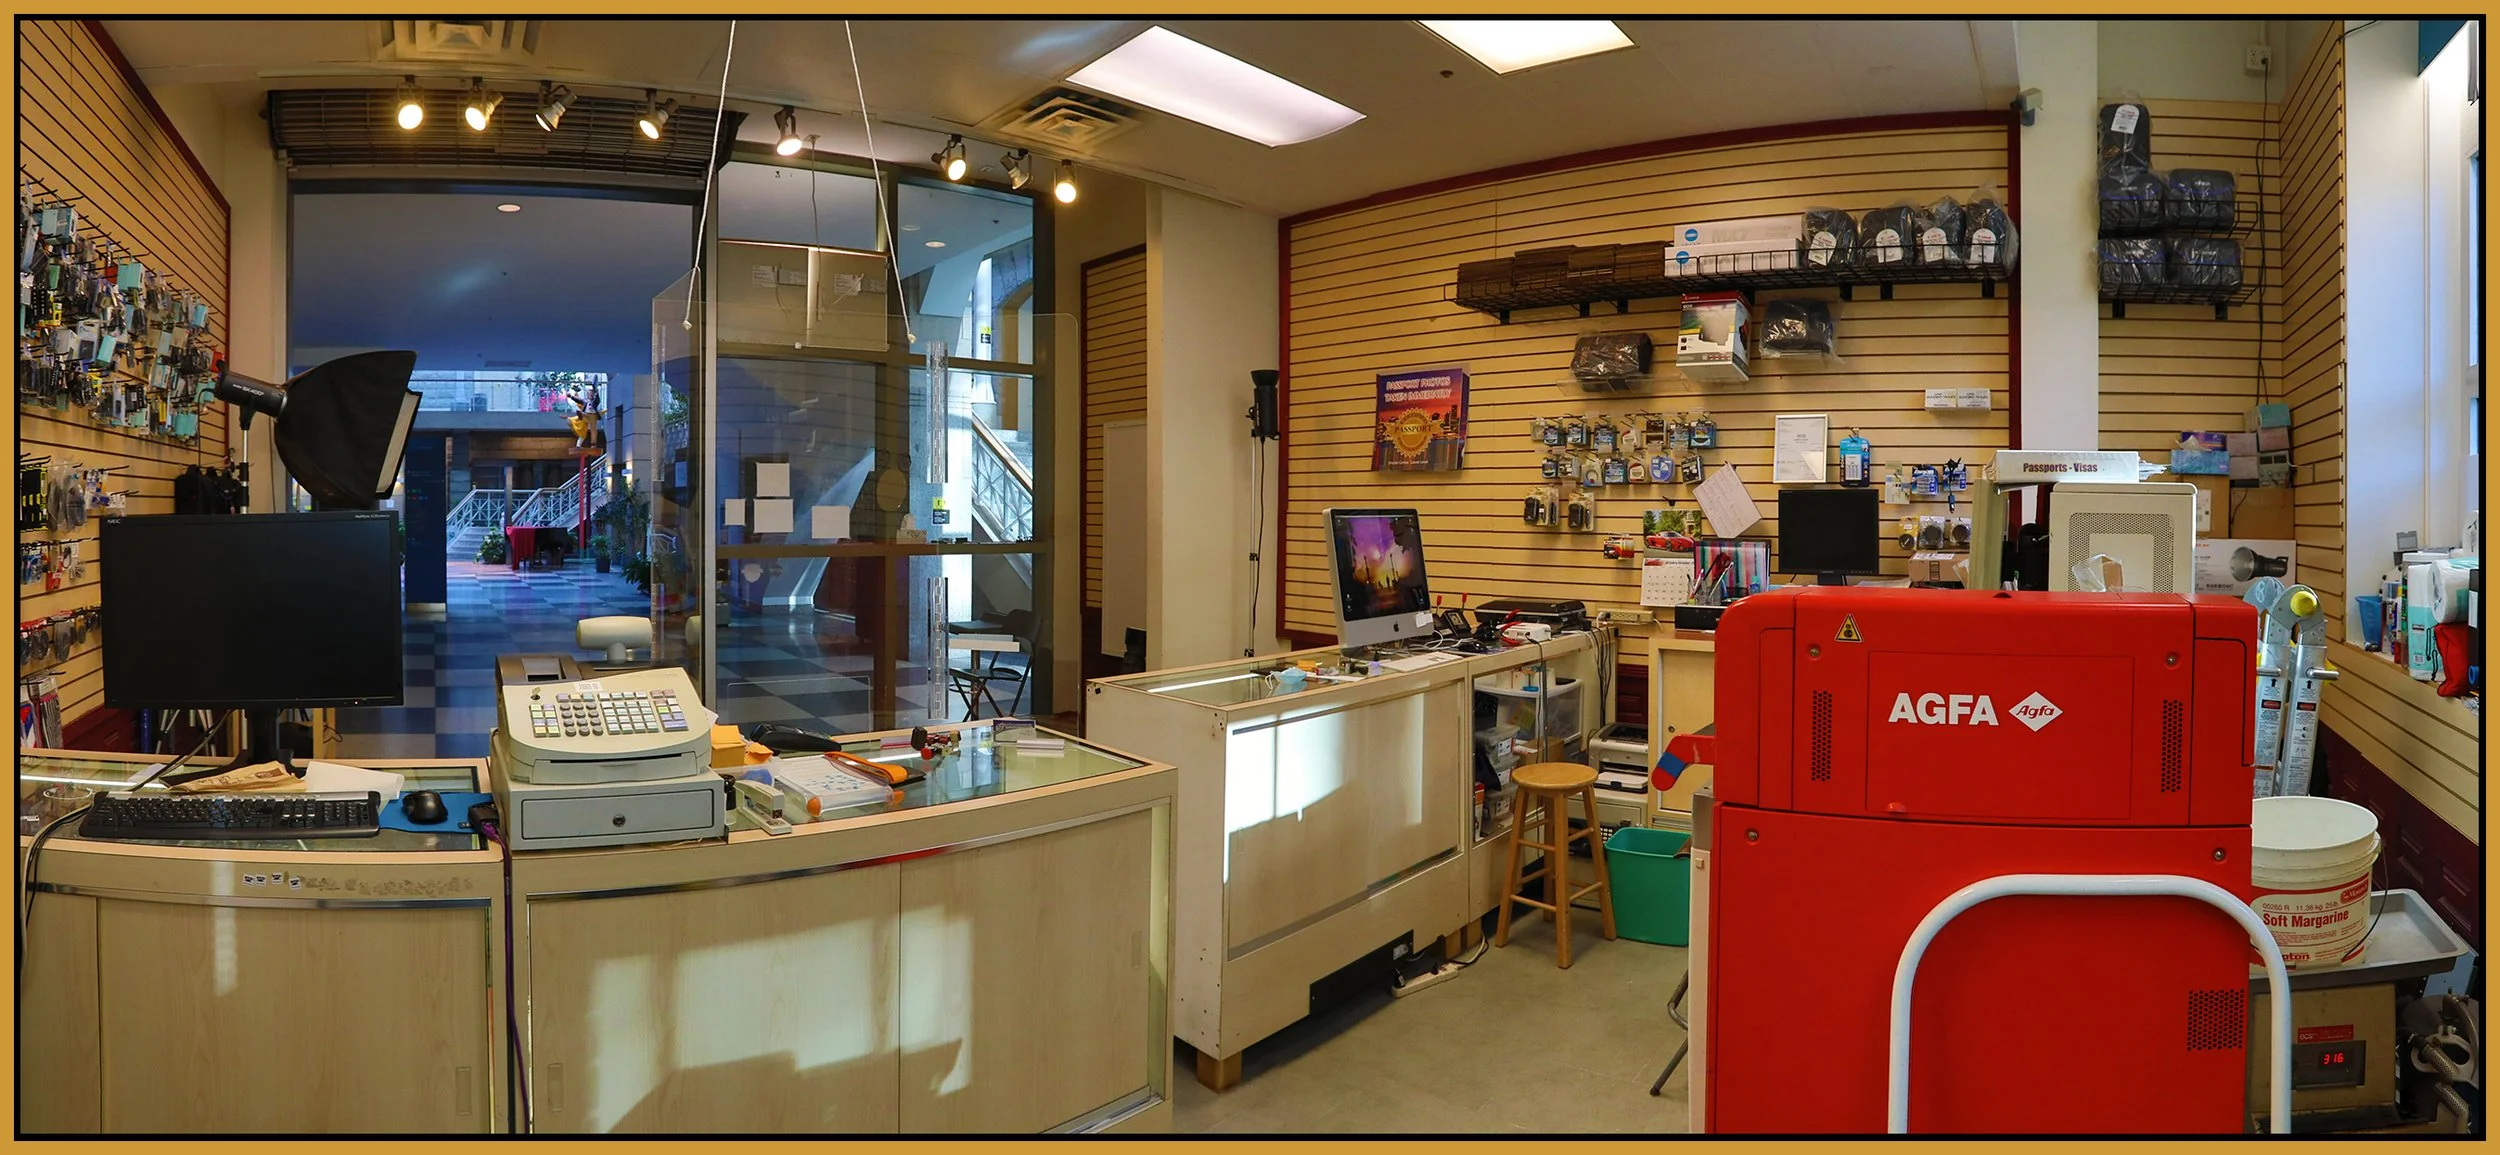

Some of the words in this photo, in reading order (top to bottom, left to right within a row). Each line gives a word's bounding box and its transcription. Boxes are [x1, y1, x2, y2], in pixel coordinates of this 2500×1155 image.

[1386, 379, 1420, 389] PASSPORT
[1421, 377, 1450, 387] PHOTOS
[1385, 392, 1407, 402] TAKEN
[1394, 425, 1432, 433] PASSPORT
[2023, 463, 2068, 473] Passports
[2073, 463, 2098, 472] Visas
[1888, 693, 1999, 726] AGFA
[2016, 705, 2055, 719] Agfa
[2315, 904, 2323, 912] kg
[2263, 913, 2288, 927] Soft
[2291, 910, 2349, 928] Margarine
